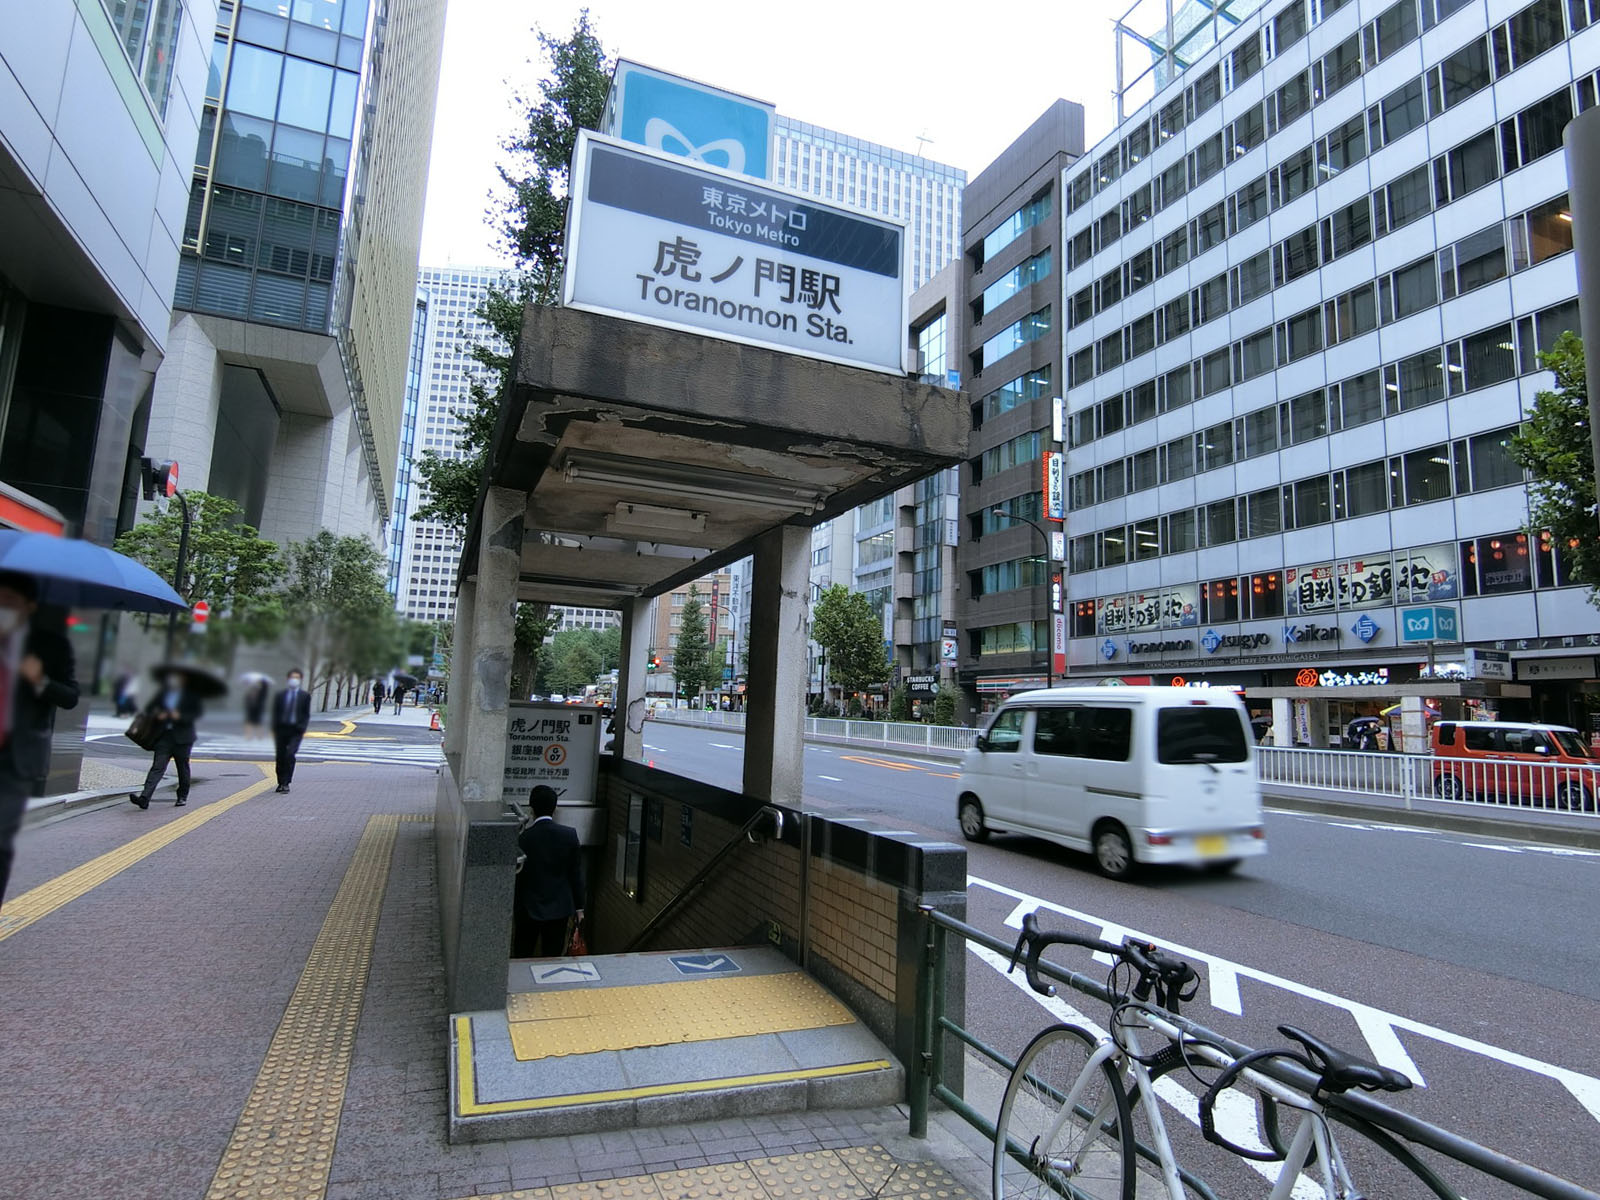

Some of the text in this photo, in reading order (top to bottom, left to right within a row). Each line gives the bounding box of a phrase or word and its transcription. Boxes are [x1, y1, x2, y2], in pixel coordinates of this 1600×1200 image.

[701, 186, 806, 231] 東京メトロ
[708, 211, 800, 246] Tokyo Metro
[652, 236, 842, 314] 虎ノ門駅
[636, 273, 853, 344] Toranomon Sta.
[1125, 638, 1193, 655] Toranomon
[1281, 623, 1341, 643] Kaikan
[907, 675, 935, 684] STARBUCKS
[911, 683, 929, 691] COFFEE
[1319, 669, 1387, 687] はなまるうどん
[509, 733, 554, 742] Toranomon
[511, 718, 571, 734] 虎ノ門駅
